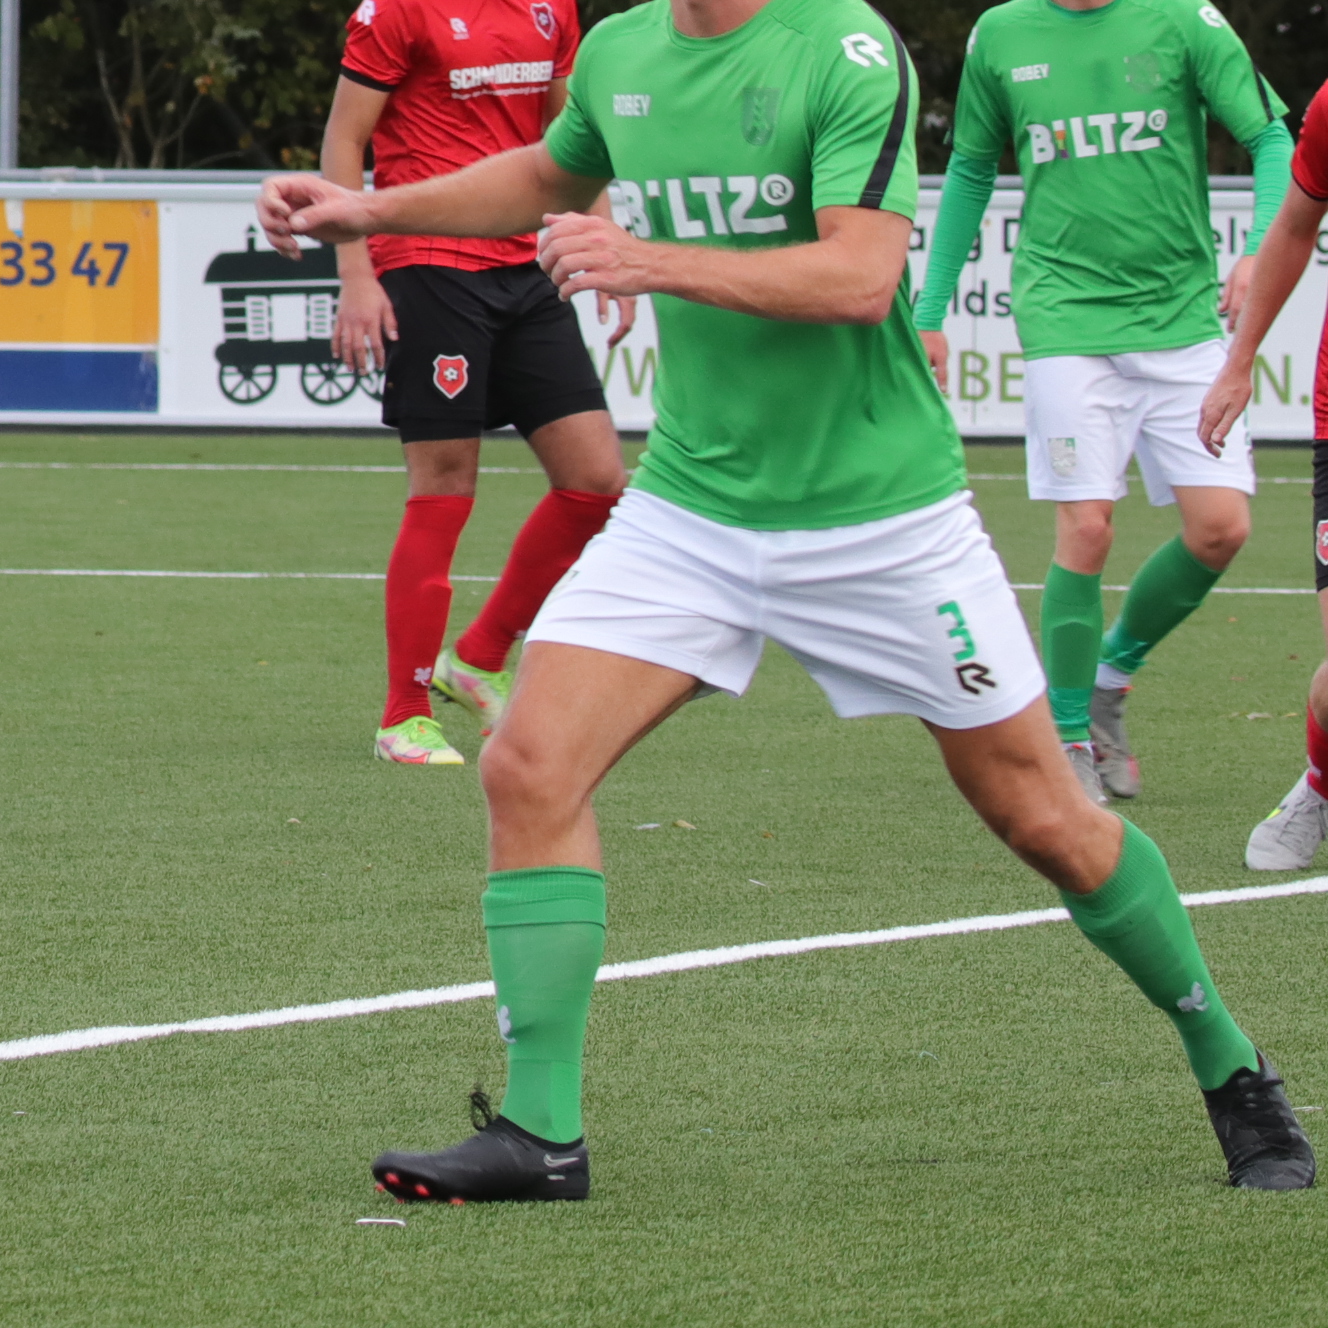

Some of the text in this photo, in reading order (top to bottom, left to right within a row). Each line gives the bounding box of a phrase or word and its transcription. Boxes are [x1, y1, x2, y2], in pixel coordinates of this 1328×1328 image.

[613, 94, 651, 117] ROBEY
[71, 242, 129, 287] 47
[937, 600, 976, 662] 3
